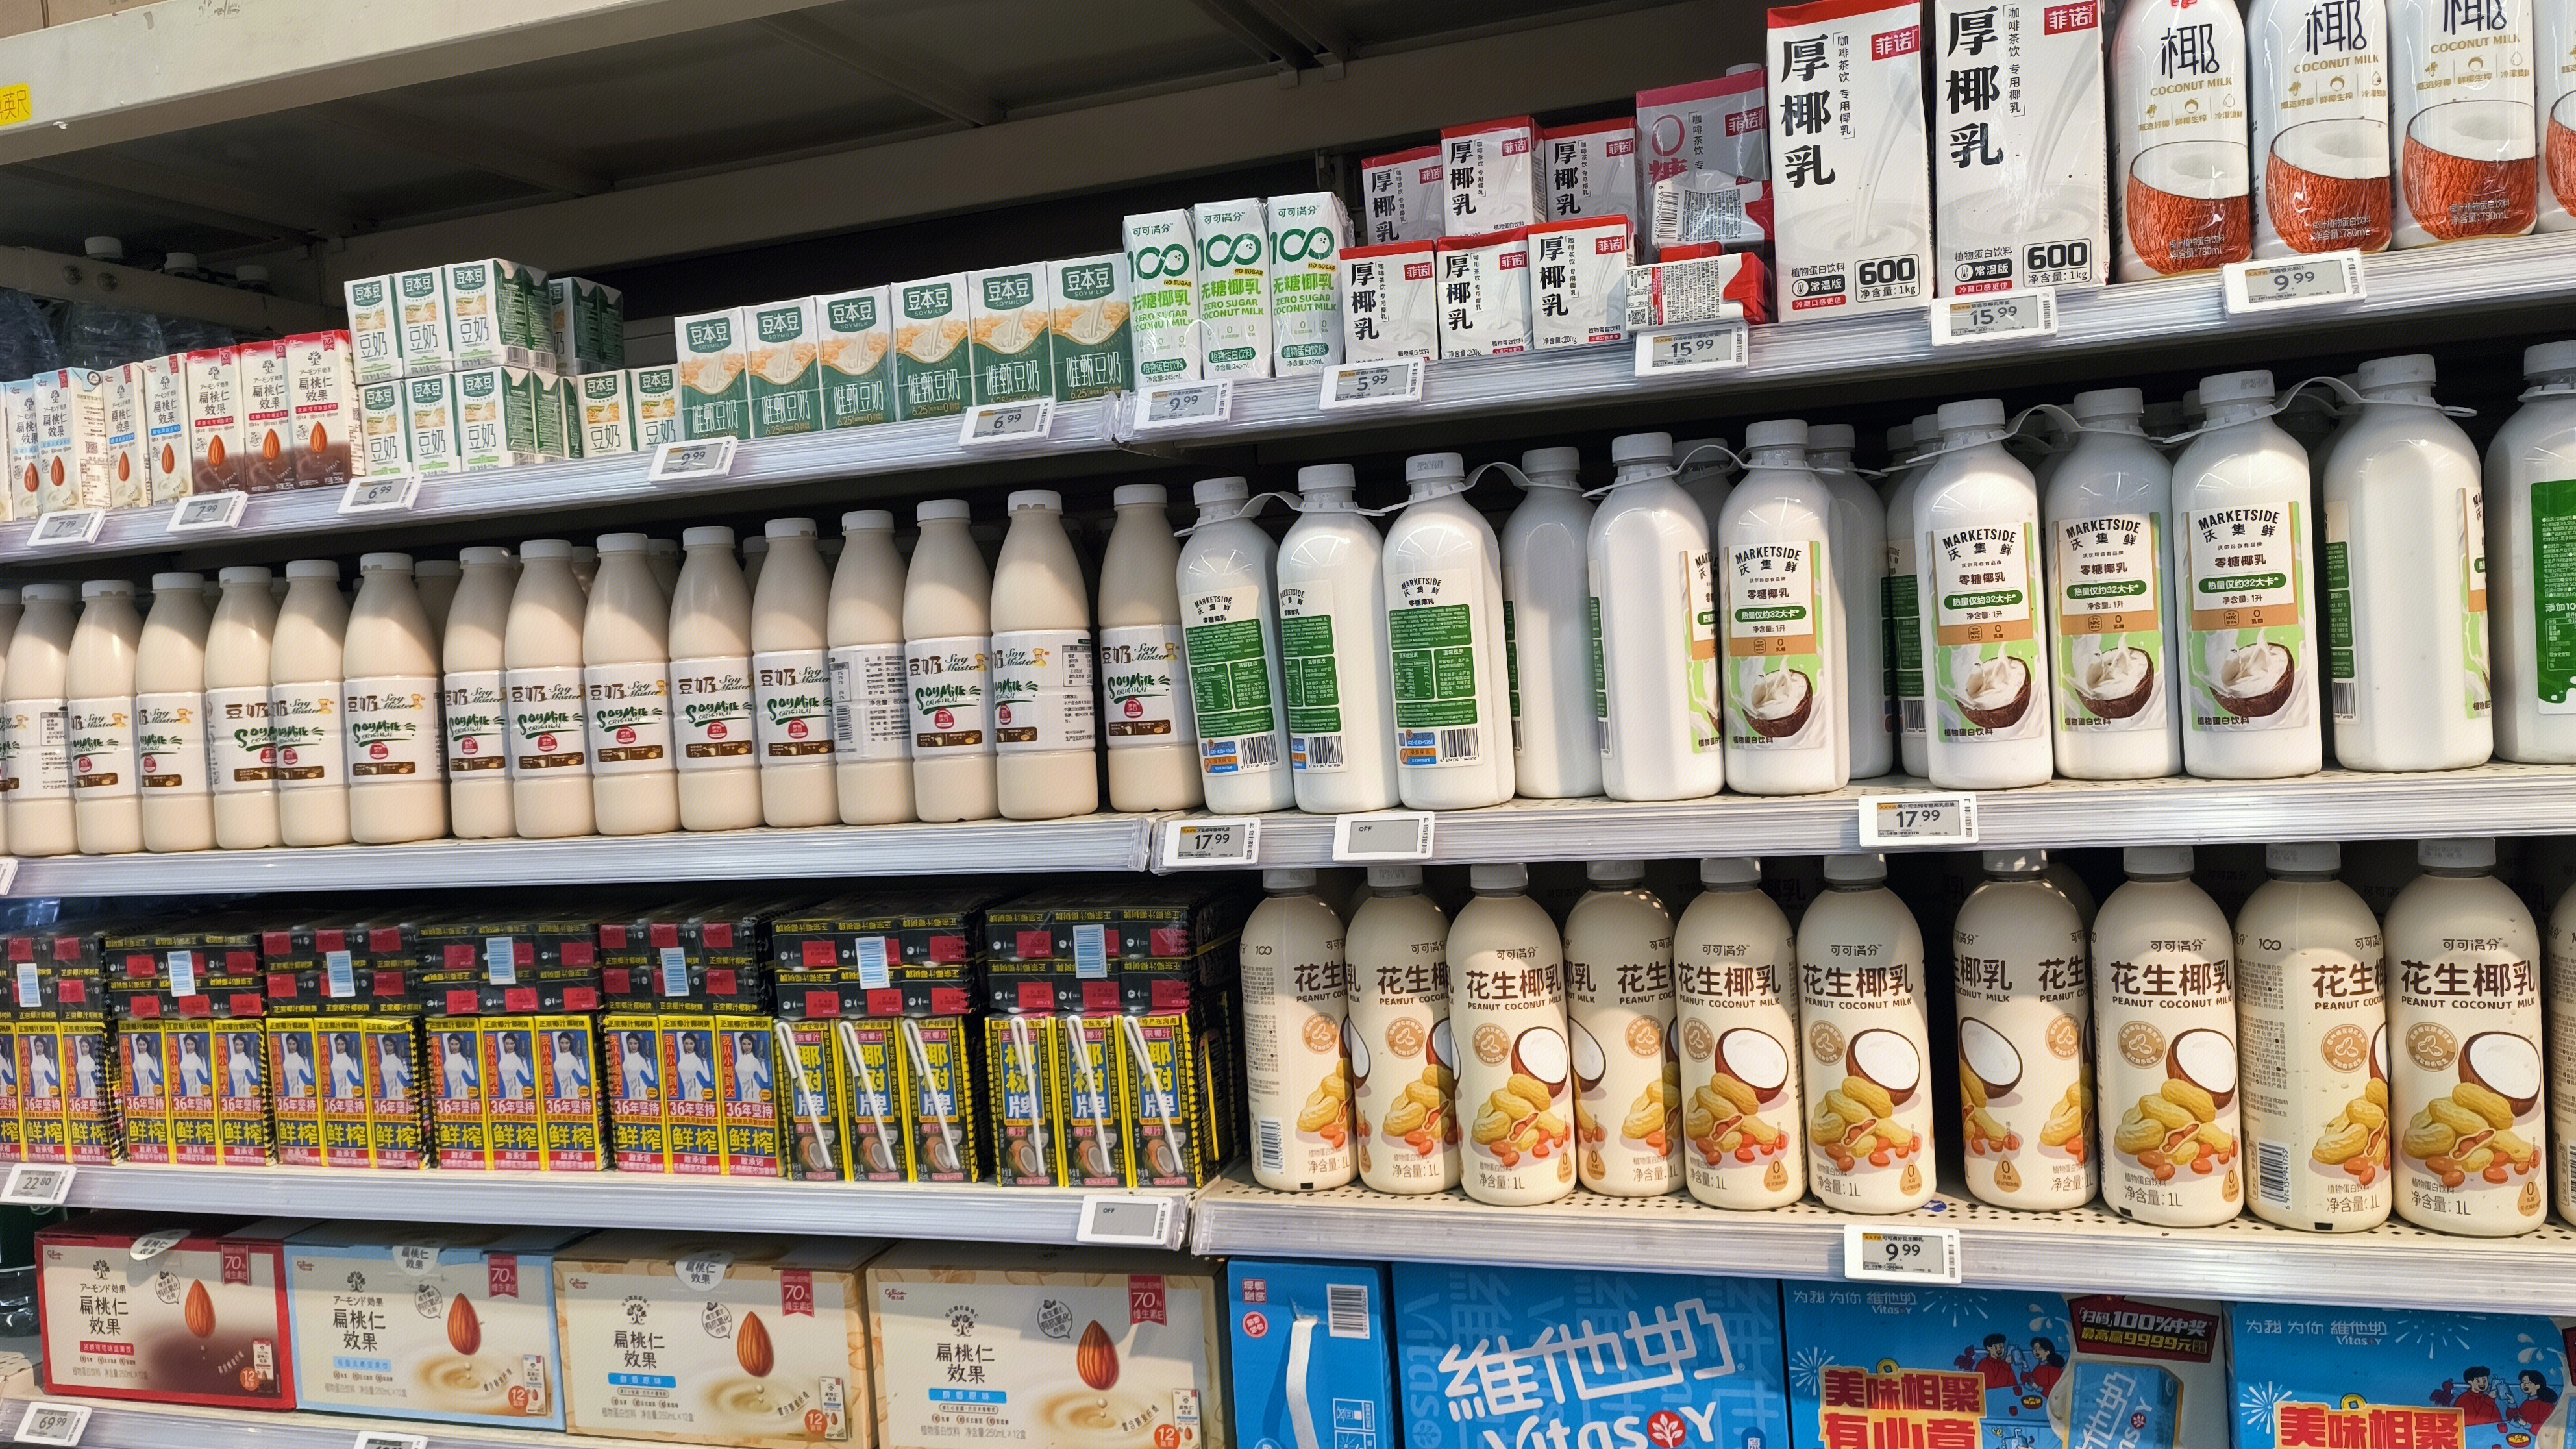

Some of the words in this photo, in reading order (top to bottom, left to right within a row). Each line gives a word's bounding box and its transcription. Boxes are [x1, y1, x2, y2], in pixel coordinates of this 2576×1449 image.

[2048, 6, 2094, 29] 菲诺
[1875, 31, 1916, 53] 菲诺
[2161, 23, 2220, 79] 椰
[2431, 37, 2490, 53] COCONUT
[2493, 34, 2520, 46] MILK
[1837, 35, 1850, 82] 咖啡茶饮
[2294, 58, 2350, 74] COCONUT
[2354, 55, 2379, 66] MILK
[1946, 6, 2003, 169] 厚椰乳
[2150, 80, 2204, 97] COCONUT
[2207, 77, 2233, 89] MILK
[0, 90, 29, 120] 英尺
[1779, 34, 1836, 188] 厚椰乳
[1450, 140, 1476, 216] 厚椰乳
[1204, 212, 1243, 225] 可可满分
[1278, 205, 1317, 217] 可可满分
[1955, 247, 2012, 262] 植物蛋白饮料
[2027, 243, 2087, 271] 600
[456, 268, 484, 285] 豆本豆
[1406, 265, 1431, 278] 菲诺
[1539, 236, 1568, 317] 厚椰乳
[1790, 262, 1845, 278] 植物蛋白饮料
[1859, 258, 1915, 286] 600
[1975, 262, 2009, 276] 常温版
[1066, 268, 1110, 291] 豆本豆
[1201, 278, 1261, 300] 无糖椰乳
[1273, 273, 1334, 295] 无糖椰乳
[1810, 278, 1842, 292] 常温版
[2273, 271, 2316, 292] 9.99
[908, 290, 949, 310] 豆本豆
[987, 279, 1030, 301] 豆本豆
[1276, 297, 1296, 306] ZERO
[1299, 294, 1331, 304] SUGAR
[1445, 254, 1473, 331] 厚椰乳
[1132, 290, 1191, 312] 无糖椰乳
[1274, 305, 1313, 316] COCONUT
[1351, 262, 1379, 340] 厚椰乳
[833, 302, 872, 323] 豆本豆
[1968, 305, 2017, 327] 15.99
[460, 317, 490, 343] 豆奶
[762, 313, 799, 334] 豆本豆
[360, 333, 388, 359] 豆奶
[1671, 339, 1714, 358] 15.99
[298, 376, 333, 392] 扁桃仁
[586, 379, 615, 395] 豆本豆
[1357, 375, 1387, 391] 5.99
[305, 389, 328, 402] 效果
[994, 414, 1021, 430] 6.99
[589, 425, 620, 450] 豆奶
[2066, 518, 2142, 539] MARKETSIDE
[2198, 509, 2280, 530] MARKETSIDE
[1942, 529, 2016, 549] MARKETSIDE
[2203, 523, 2277, 543] 沃集鲜
[1735, 546, 1802, 565] MARKETSIDE
[1948, 543, 2012, 562] 沃集鲜
[2214, 554, 2266, 568] 零糖椰乳
[1739, 559, 1797, 576] 沃集鲜
[2080, 562, 2128, 576] 零糖椰乳
[1401, 577, 1442, 590] MARKETSIDE
[1959, 571, 2005, 585] 零糖椰乳
[1747, 588, 1789, 600] 零糖椰乳
[1102, 645, 1131, 664] 豆奶
[1134, 643, 1158, 656] Soy
[909, 656, 942, 676] 豆奶
[678, 676, 715, 694] 豆奶
[760, 668, 795, 686] 豆奶
[1895, 810, 1941, 830] 17.99
[1193, 834, 1230, 852] 17.99
[1496, 948, 1537, 960] 可可满分
[2151, 939, 2204, 952] 可可满分
[2442, 937, 2499, 952] 可可满分
[1467, 963, 1562, 1002] 花生椰乳
[1803, 963, 1913, 998] 花生椰乳
[2110, 959, 2232, 997] 花生椰乳
[2401, 959, 2535, 998] 花生椰乳
[1805, 998, 1835, 1009] PEANUT
[1839, 1000, 1889, 1010] COCONUT
[1893, 997, 1913, 1008] MILK
[2112, 996, 2153, 1008] PEANUT
[2159, 998, 2212, 1009] COCONUT
[2216, 995, 2232, 1006] MILK
[2401, 995, 2445, 1008] PEANUT
[2451, 999, 2512, 1009] COCONUT
[2517, 995, 2535, 1008] MILK
[546, 1101, 593, 1115] 36年坚持
[726, 1103, 773, 1119] 36年坚持
[129, 1121, 166, 1145] 鲜榨
[548, 1125, 595, 1149] 鲜榨
[729, 1127, 774, 1155] 鲜榨
[1885, 1243, 1920, 1262] 9.99
[79, 1296, 129, 1317] 扁桃仁
[1793, 1291, 1825, 1304] 为我
[1829, 1292, 1861, 1304] 为你
[1867, 1292, 1916, 1305] 維他奶
[89, 1316, 121, 1337] 效果
[333, 1309, 386, 1331] 扁桃仁
[343, 1330, 378, 1352] 效果
[613, 1330, 665, 1351] 扁桃仁
[623, 1350, 658, 1370] 效果
[936, 1343, 995, 1363] 扁桃仁
[1437, 1297, 1736, 1422] 維他奶
[947, 1364, 985, 1384] 效果
[1824, 1370, 1980, 1413] 美味相聚
[1159, 1428, 1175, 1441] 12
[2281, 1407, 2459, 1449] 美味相聚
